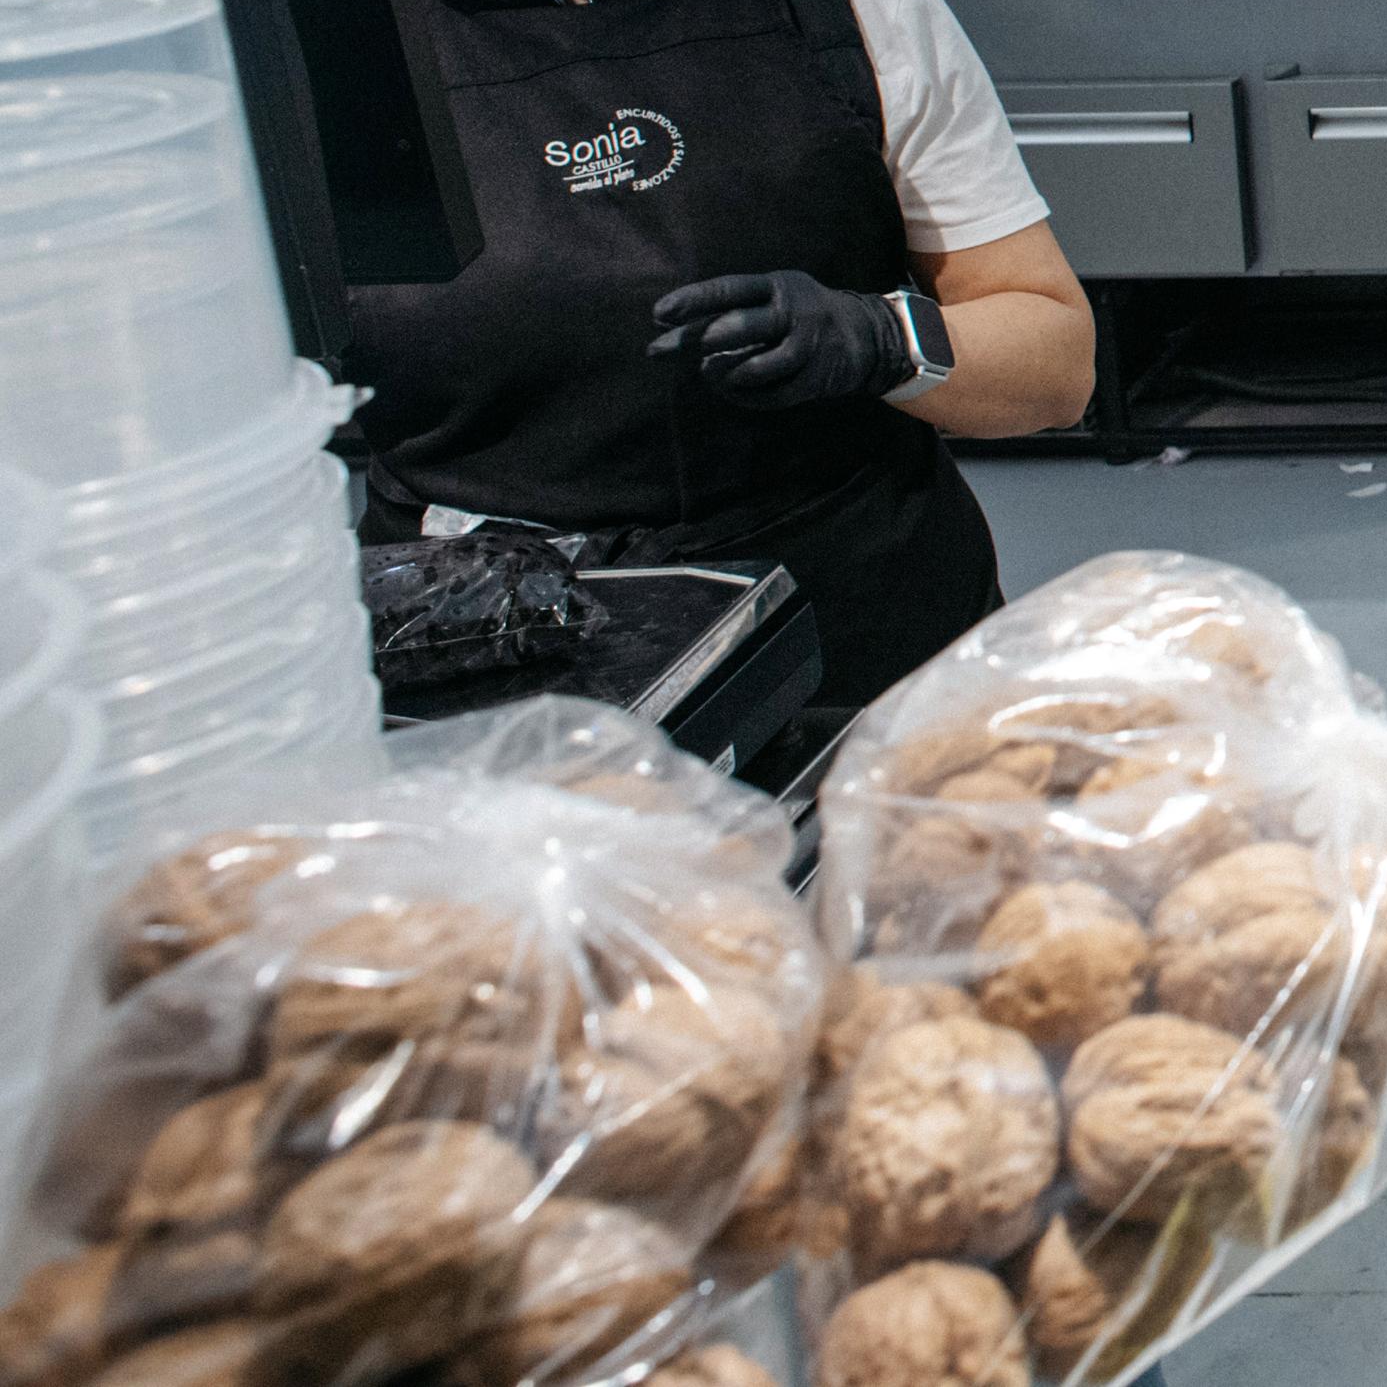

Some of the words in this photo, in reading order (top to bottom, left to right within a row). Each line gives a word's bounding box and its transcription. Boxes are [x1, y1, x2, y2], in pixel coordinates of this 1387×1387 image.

[615, 108, 682, 140] ENCURTIDOS
[544, 122, 647, 167] Sonia
[572, 154, 623, 175] CASTILLO
[632, 149, 685, 192] SALAZONES
